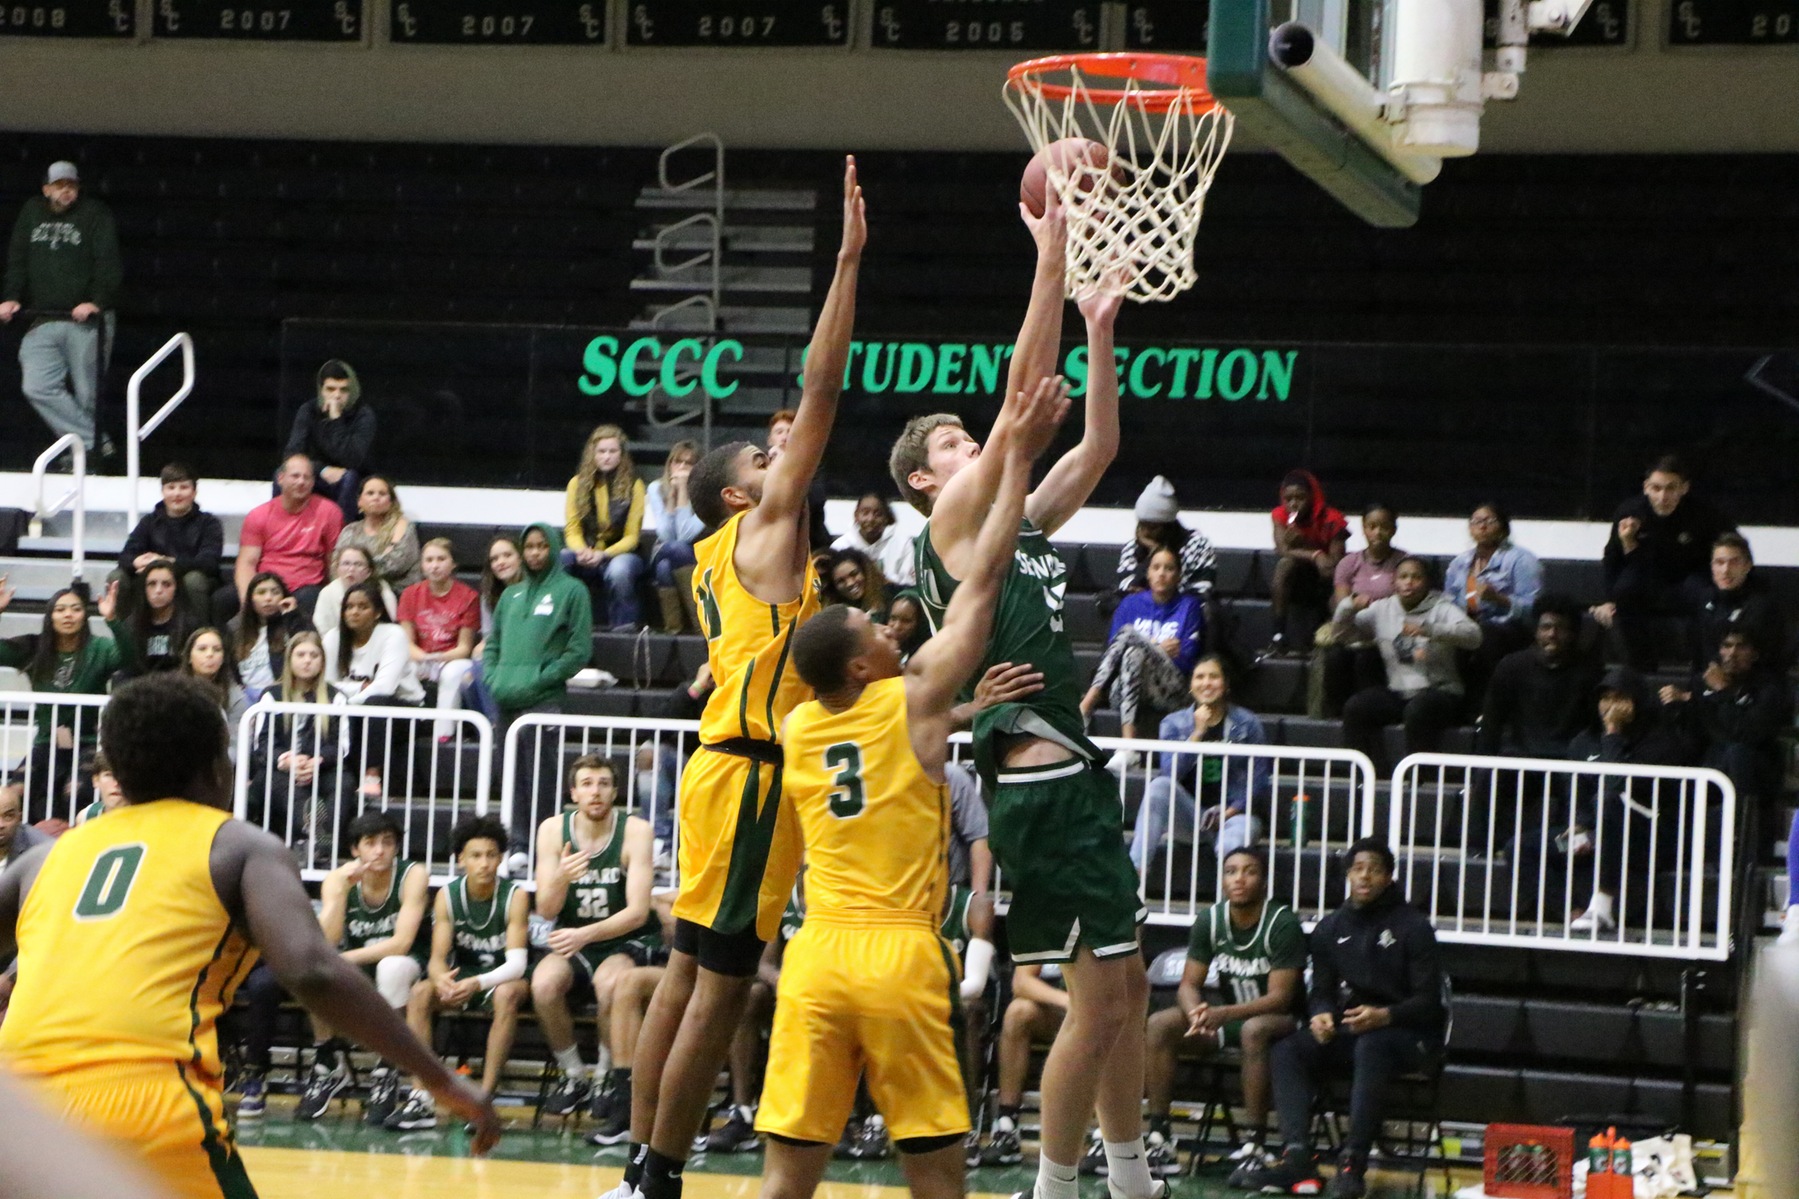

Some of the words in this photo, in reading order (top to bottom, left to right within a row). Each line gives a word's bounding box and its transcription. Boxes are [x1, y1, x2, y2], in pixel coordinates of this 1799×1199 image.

[220, 9, 291, 30] 2007
[462, 15, 535, 36] 2007
[700, 16, 775, 37] 2007
[578, 335, 743, 399] SCCC
[797, 341, 1014, 394] TUDEN
[824, 741, 867, 819] 3
[72, 841, 148, 921] 0
[570, 867, 620, 885] WARD
[576, 887, 609, 919] 32
